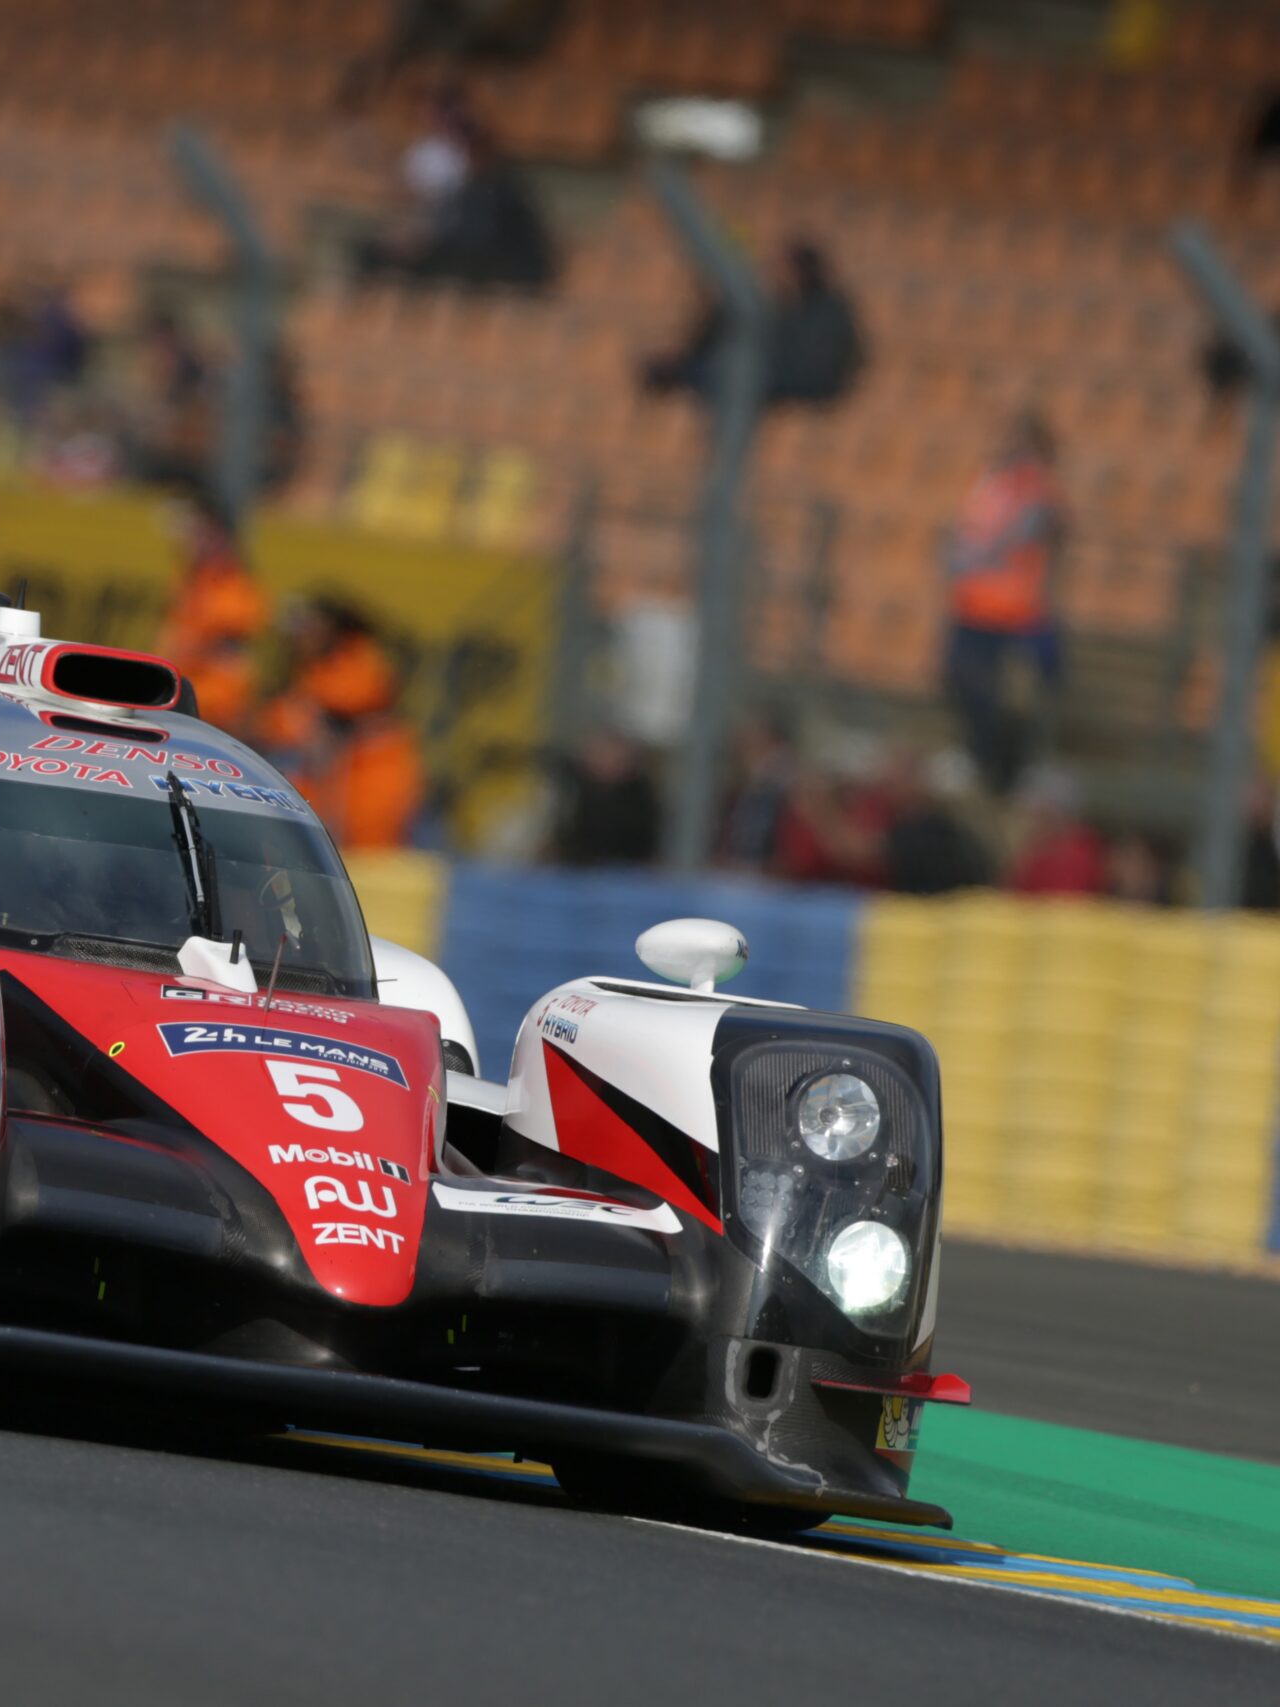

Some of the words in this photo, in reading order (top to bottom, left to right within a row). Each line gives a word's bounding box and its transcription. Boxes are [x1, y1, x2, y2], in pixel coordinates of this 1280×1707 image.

[29, 734, 244, 780] DENSO
[542, 1013, 580, 1045] HYBRID
[255, 1035, 293, 1048] LE
[300, 1041, 390, 1071] MANS
[265, 1060, 365, 1133] 5
[268, 1144, 375, 1171] Mobil
[312, 1222, 405, 1255] ZENT
